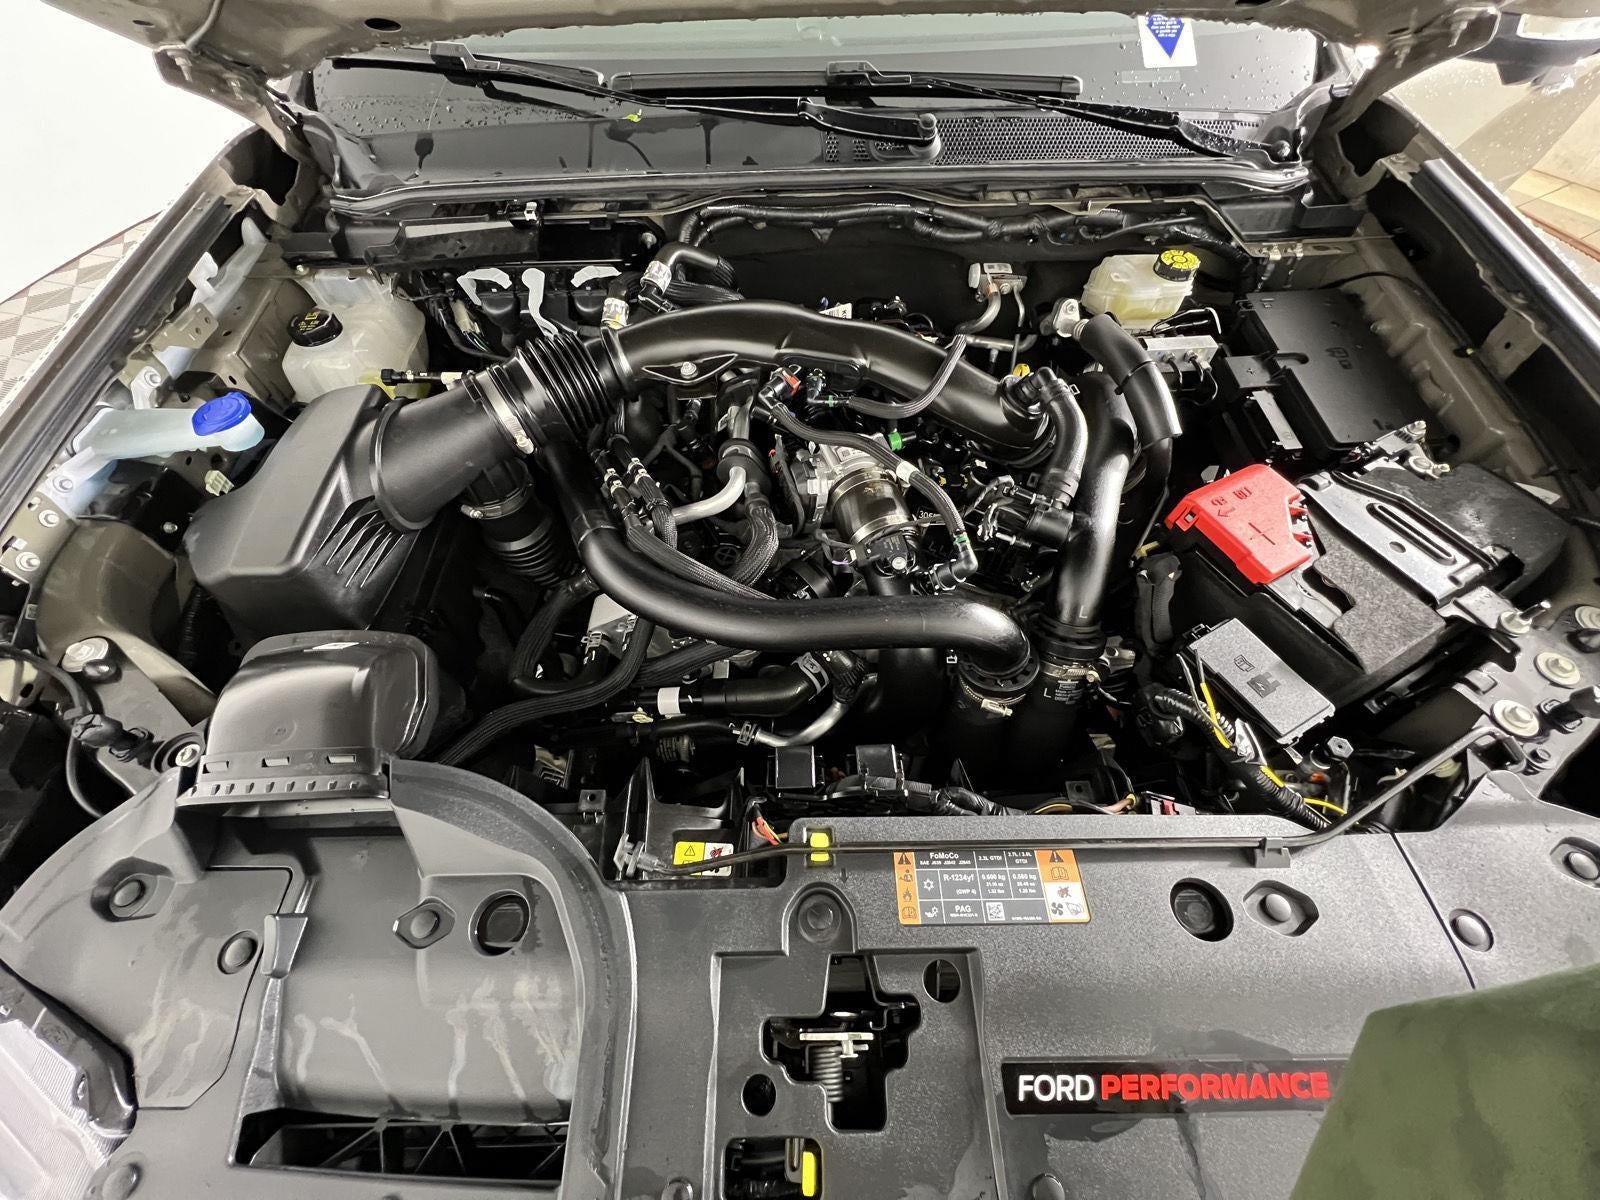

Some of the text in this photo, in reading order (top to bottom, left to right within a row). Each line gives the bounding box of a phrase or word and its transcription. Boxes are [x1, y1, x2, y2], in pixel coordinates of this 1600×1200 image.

[929, 852, 959, 860] FoMoCo
[943, 873, 974, 883] R-1234yf
[998, 874, 1007, 882] kg
[955, 905, 971, 913] PAG
[1018, 1071, 1331, 1102] FORD PERFORMANCE
